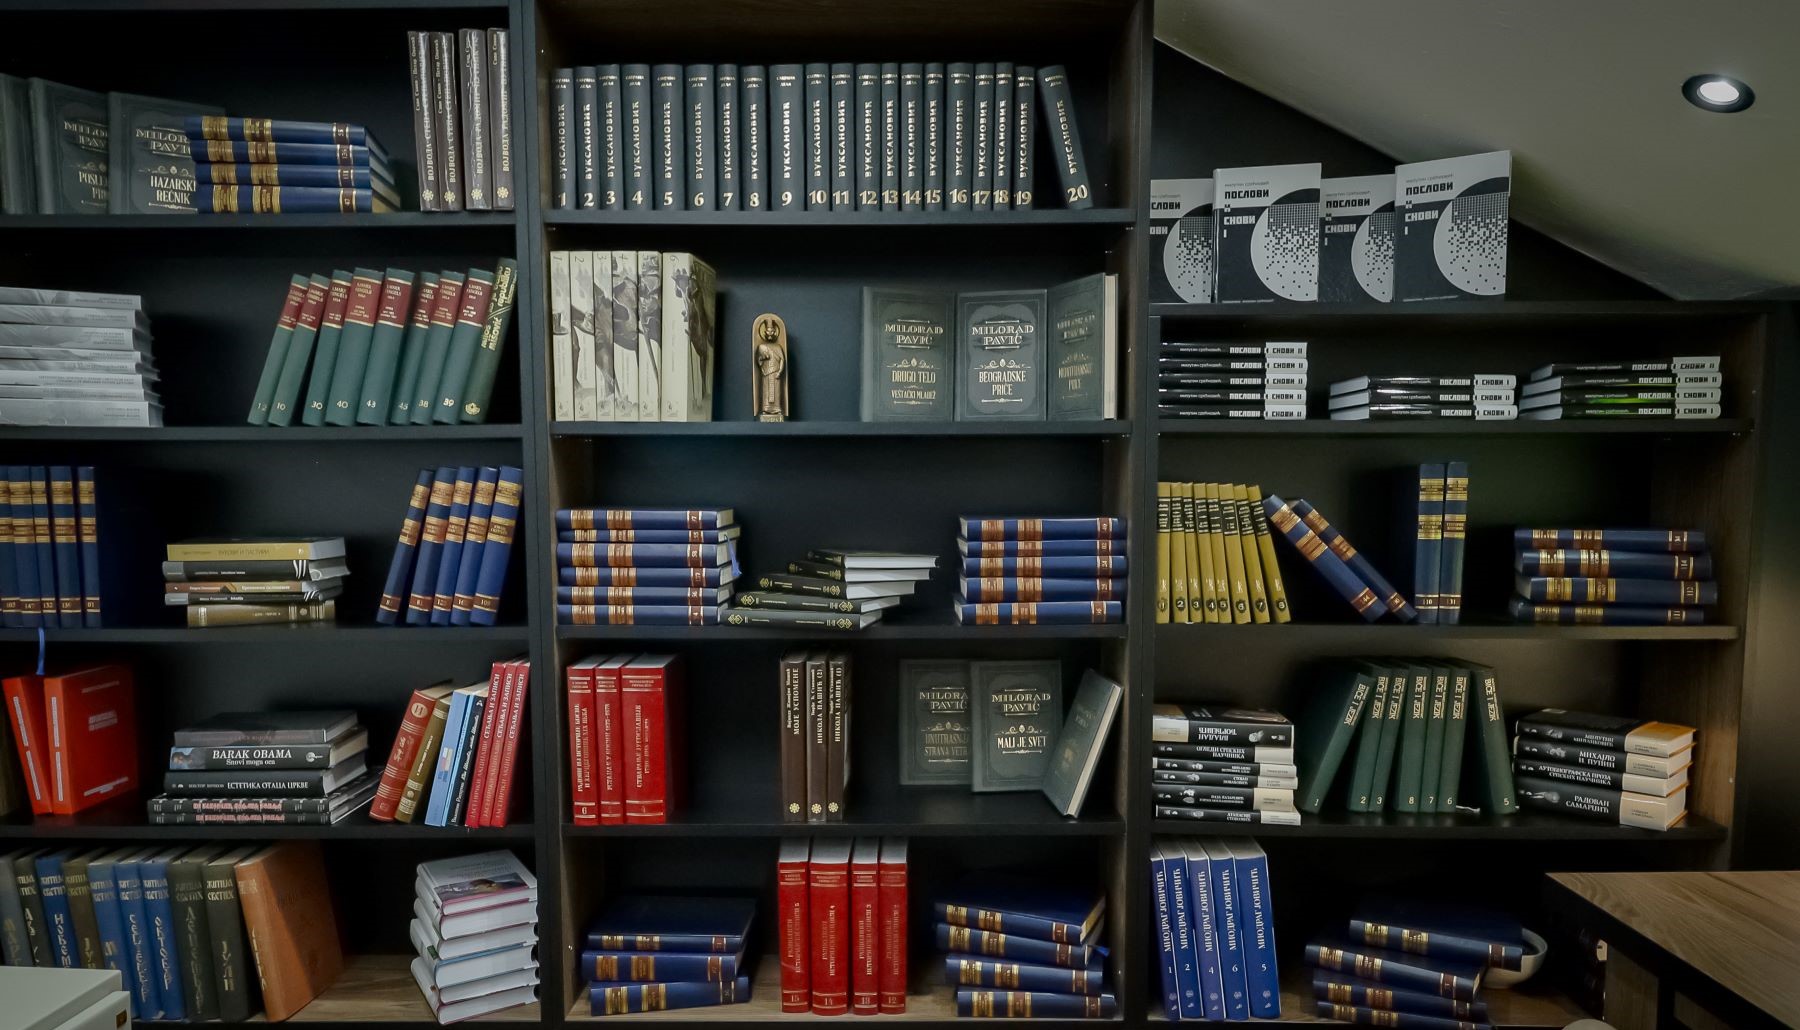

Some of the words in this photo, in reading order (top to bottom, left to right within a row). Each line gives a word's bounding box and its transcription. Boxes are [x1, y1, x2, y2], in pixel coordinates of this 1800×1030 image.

[136, 128, 190, 144] MILOR
[583, 103, 592, 180] ВУКСАНОВИЋ
[632, 101, 642, 178] ВУКСАНОВИЋ
[694, 102, 704, 180] ВУКСАНОВИЋ
[750, 103, 760, 180] ВУКСАНОВИЋ
[813, 100, 822, 177] ВУКСАНОВИЋ
[864, 101, 874, 178] ВУКСАНОВИЋ
[907, 100, 917, 178] ВУКСАНОВИЋ
[929, 100, 937, 177] ВУКСАНОВИЋ
[955, 100, 965, 177] ВУКСАНОВИЋ
[978, 100, 988, 178] ВУКСАНОВИЋ
[1019, 102, 1029, 179] ВУКСАНОВИЋ
[1056, 100, 1078, 175] ВУКСАНОВИЋ
[152, 141, 190, 155] PAVI
[151, 176, 196, 192] HAZARSKI
[1405, 182, 1454, 196] ПОСЛОВИ
[558, 192, 566, 207] 1
[583, 192, 595, 207] 2
[606, 190, 616, 205] 3
[632, 190, 643, 205] 4
[663, 191, 673, 206] 5
[694, 192, 705, 206] 6
[723, 192, 733, 206] 7
[750, 192, 760, 207] 8
[781, 191, 792, 206] 9
[809, 190, 826, 204] 10
[833, 189, 849, 205] 11
[859, 190, 877, 205] 12
[882, 189, 899, 204] 13
[902, 189, 921, 205] 14
[924, 189, 941, 204] 15
[949, 188, 967, 204] 16
[972, 190, 991, 204] 17
[993, 189, 1009, 204] 18
[1014, 190, 1032, 205] 19
[1067, 184, 1088, 203] 20
[1224, 189, 1269, 200] ПОСЛОВИ
[1326, 198, 1370, 209] ПОСЛОВИ
[1223, 215, 1256, 225] СНОВИ
[1405, 210, 1439, 222] СНОВИ
[1324, 224, 1357, 234] СНОВИ
[885, 324, 944, 335] MILORAD
[972, 324, 1034, 336] MILORAD
[983, 333, 1022, 345] PAVIĆ
[892, 371, 916, 383] DRUGO
[918, 371, 936, 383] TELO
[979, 370, 1026, 383] BEOGRADSKE
[311, 401, 323, 410] 30
[336, 400, 348, 409] 40
[490, 673, 500, 702] ЗАПИСИ
[515, 673, 525, 702] ЗАПИСИ
[919, 691, 968, 701] MILORA
[992, 693, 1050, 703] MILORAD
[1003, 700, 1040, 712] PAVIĆ
[1412, 699, 1421, 719] JEZIK
[997, 737, 1016, 749] MALI
[1016, 737, 1027, 748] JE
[1028, 736, 1046, 748] SVET
[212, 750, 250, 759] BARAK
[253, 750, 292, 759] OBAMA
[226, 758, 244, 766] Snovi
[1579, 751, 1616, 762] МИХАЈЛО
[1587, 758, 1615, 768] ПУПИН
[227, 781, 260, 789] ЕСТЕТИКА
[261, 781, 286, 790] ОТАЦА
[287, 781, 309, 790] ЦРКВЕ
[1361, 796, 1366, 804] 2
[1575, 795, 1610, 807] РАДОВАН
[1173, 869, 1185, 911] ЈОВИЧИЋ
[1222, 870, 1233, 911] ЈОВИЧИЋ
[1251, 868, 1261, 911] ЈОВИЧИЋ
[1178, 911, 1188, 949] МИОДРАГ
[1226, 911, 1236, 950] МИОДРАГ
[1255, 911, 1265, 949] МИОДРАГ
[1232, 964, 1238, 972] 6
